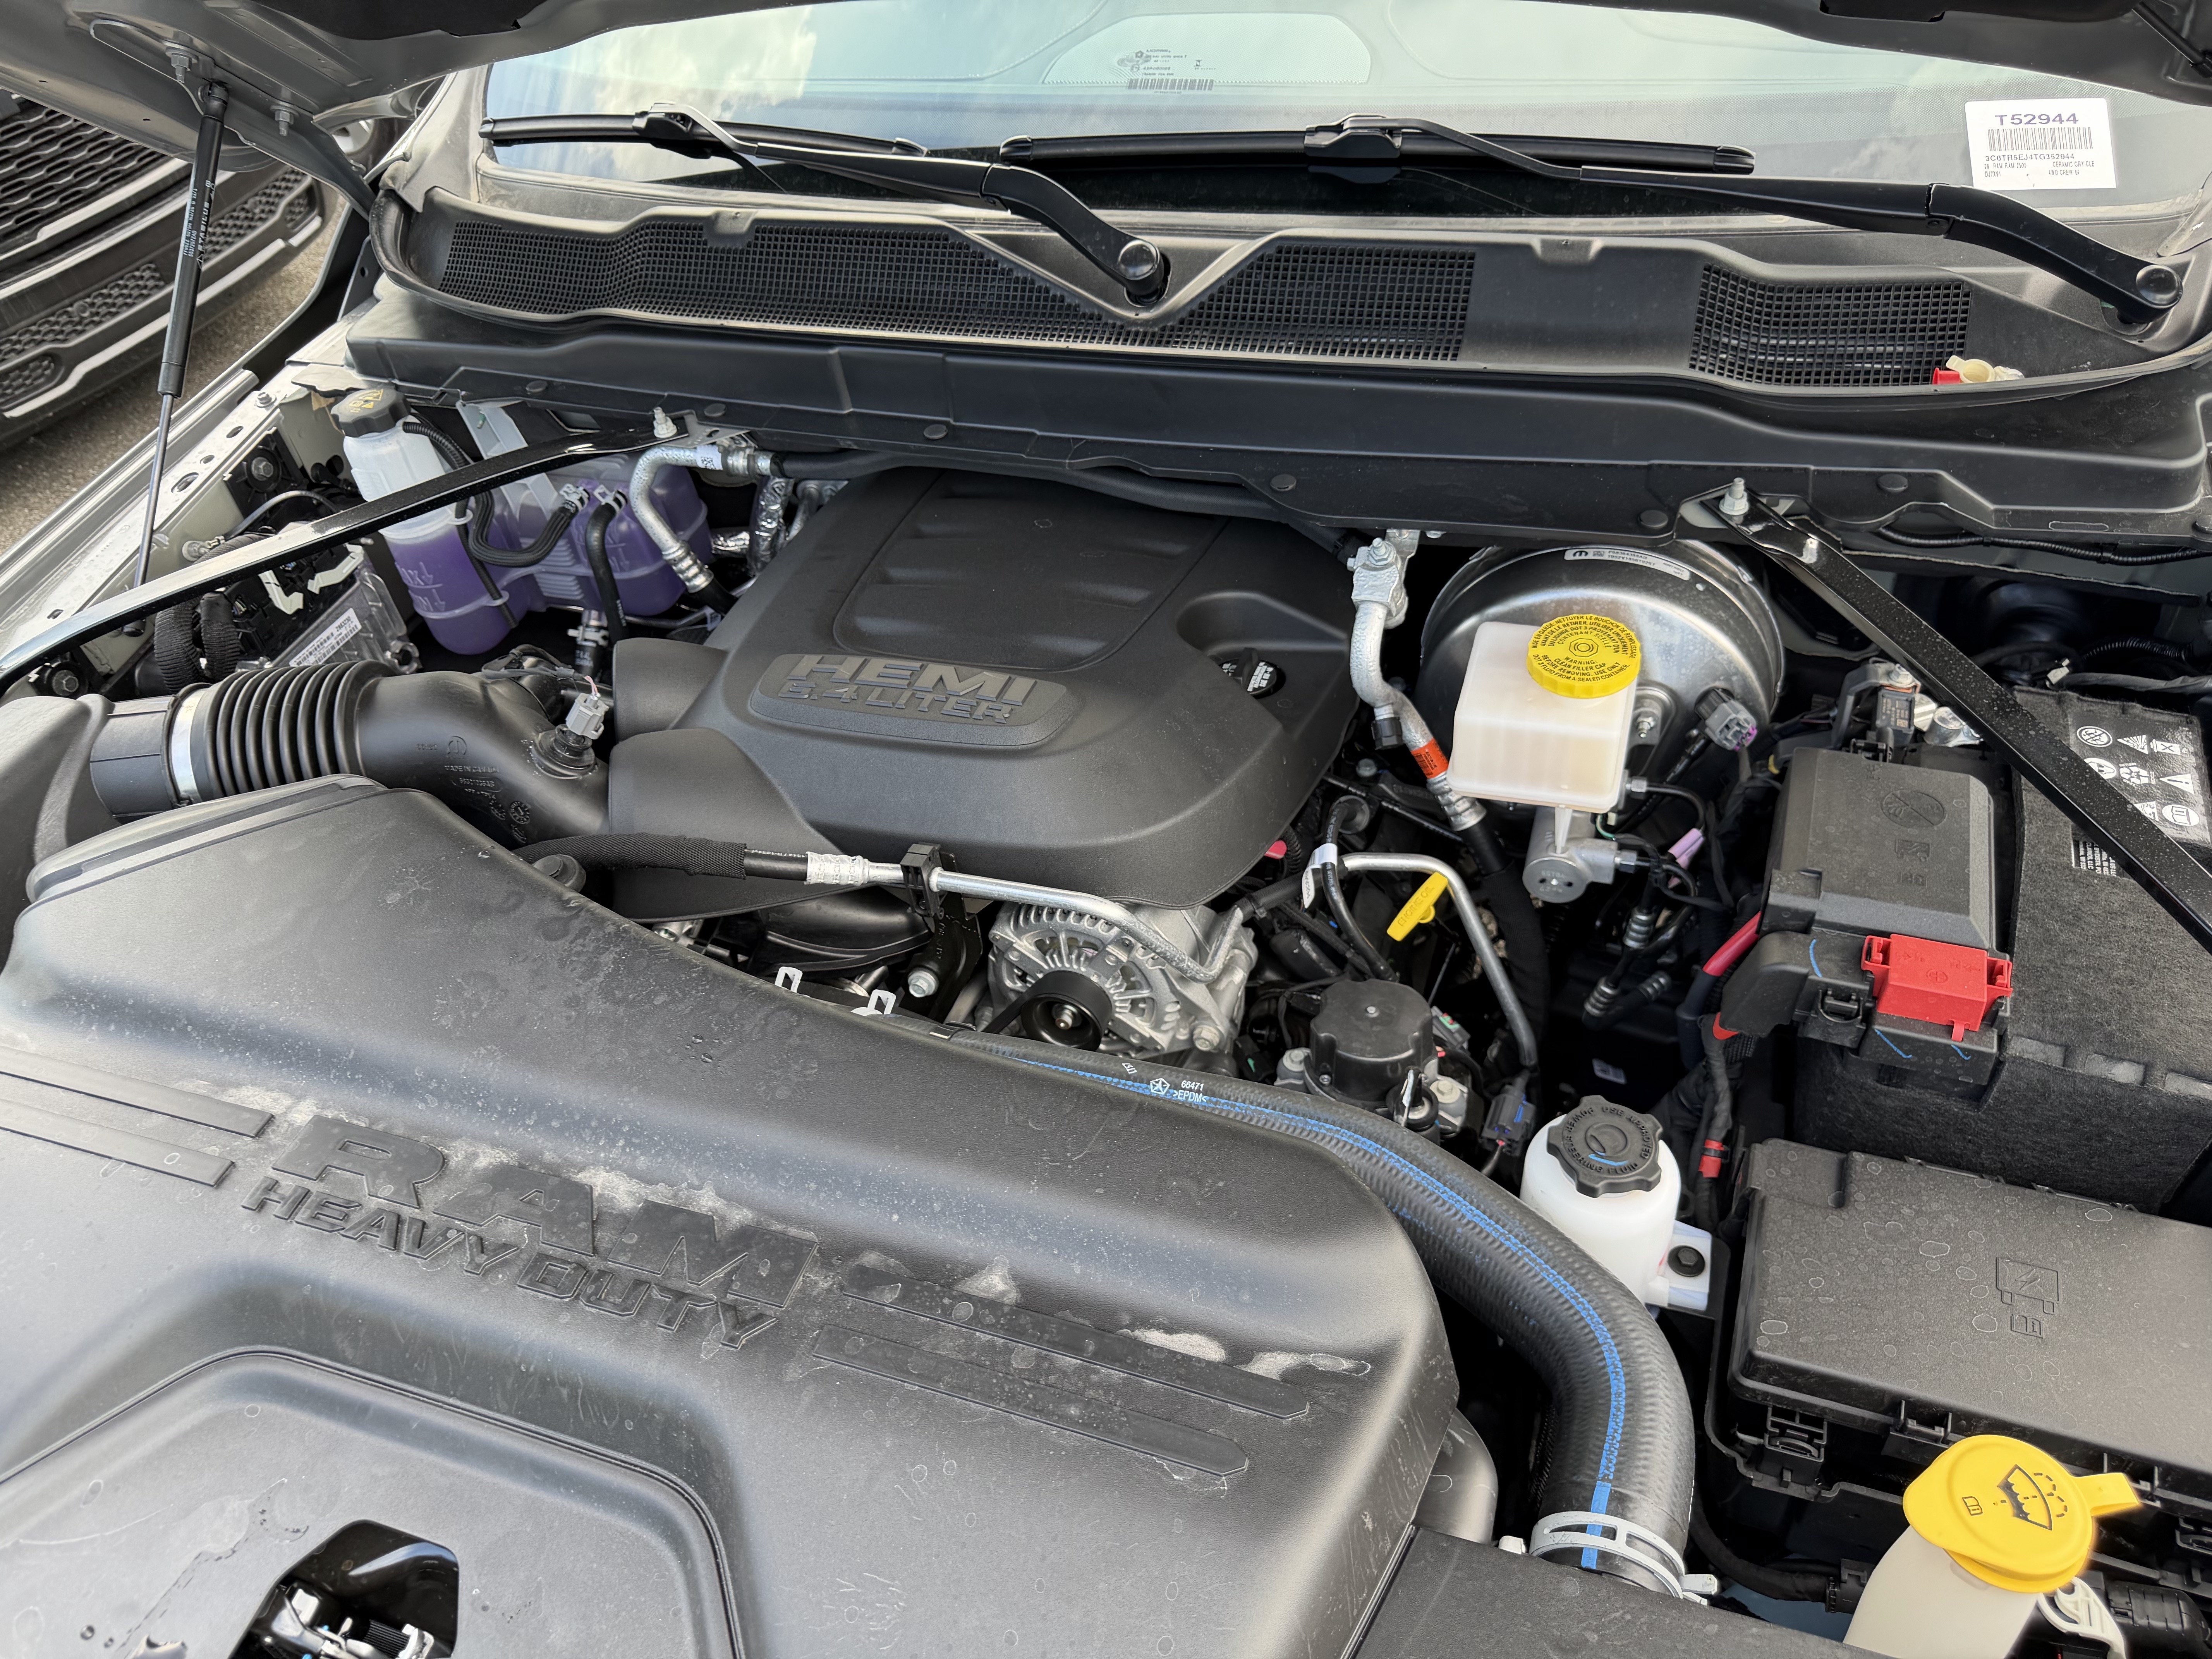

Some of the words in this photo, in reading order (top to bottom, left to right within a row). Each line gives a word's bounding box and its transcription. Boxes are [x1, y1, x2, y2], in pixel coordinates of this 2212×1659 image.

[1995, 113, 2079, 126] T52944
[1555, 616, 1584, 624] NETTOYER
[1594, 617, 1621, 629] BOUCHON
[1557, 631, 1593, 645] CONTENANT
[1554, 658, 1572, 668] CLEAN
[1564, 656, 1598, 665] WARNING:
[1607, 662, 1621, 671] ONLY
[787, 655, 1037, 706] HEMI
[1181, 1080, 1204, 1091] 66471
[1602, 1106, 1624, 1116] USE
[1626, 1115, 1652, 1159] APPROVED
[271, 1115, 818, 1309] RAM
[242, 1177, 522, 1275] HEAVY
[517, 1252, 777, 1350] DUTY
